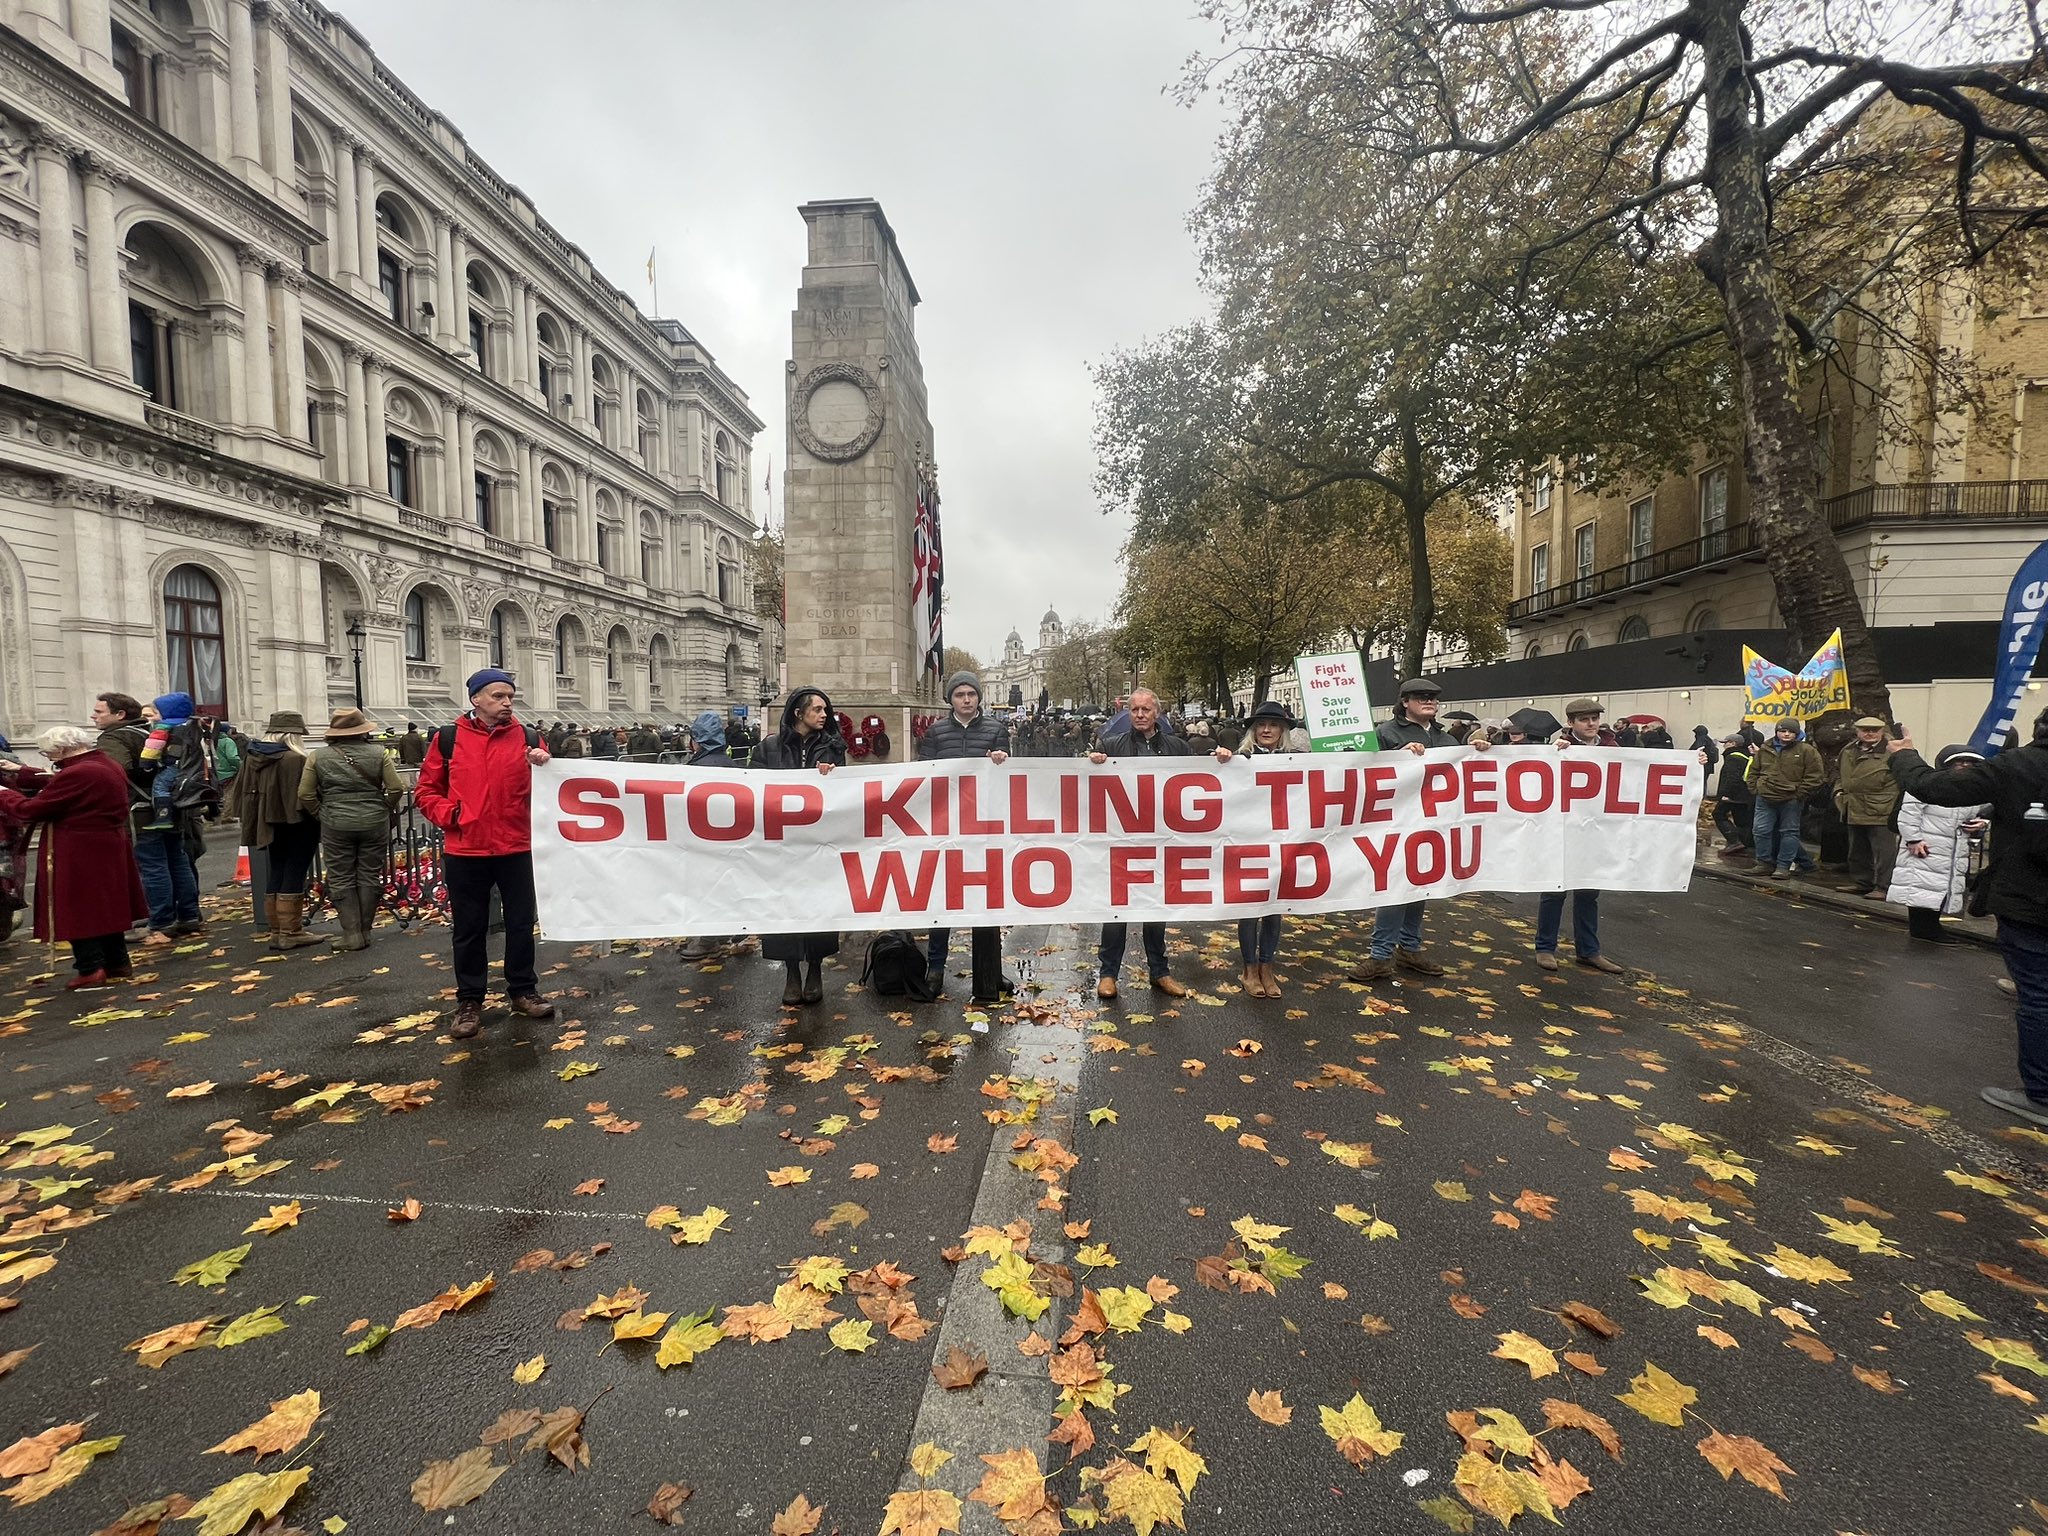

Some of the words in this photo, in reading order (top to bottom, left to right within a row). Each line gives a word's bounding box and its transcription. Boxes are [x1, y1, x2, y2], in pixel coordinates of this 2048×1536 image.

[823, 310, 852, 321] MCM
[826, 327, 849, 337] XIV
[826, 591, 851, 602] THE
[806, 608, 872, 619] GLORIOUS
[821, 625, 857, 636] DEAD
[1315, 663, 1346, 676] Fight
[1310, 679, 1330, 689] the
[1333, 676, 1355, 687] Tax
[1322, 697, 1351, 707] Save
[1329, 707, 1349, 717] our
[1321, 716, 1359, 727] Farms
[558, 778, 823, 843] STOP
[863, 773, 1223, 838] KILLING
[1256, 765, 1397, 831] THE
[1421, 760, 1686, 817] PEOPLE
[841, 847, 1073, 913] WHO
[1110, 842, 1331, 907] FEED
[1354, 826, 1481, 892] YOU
